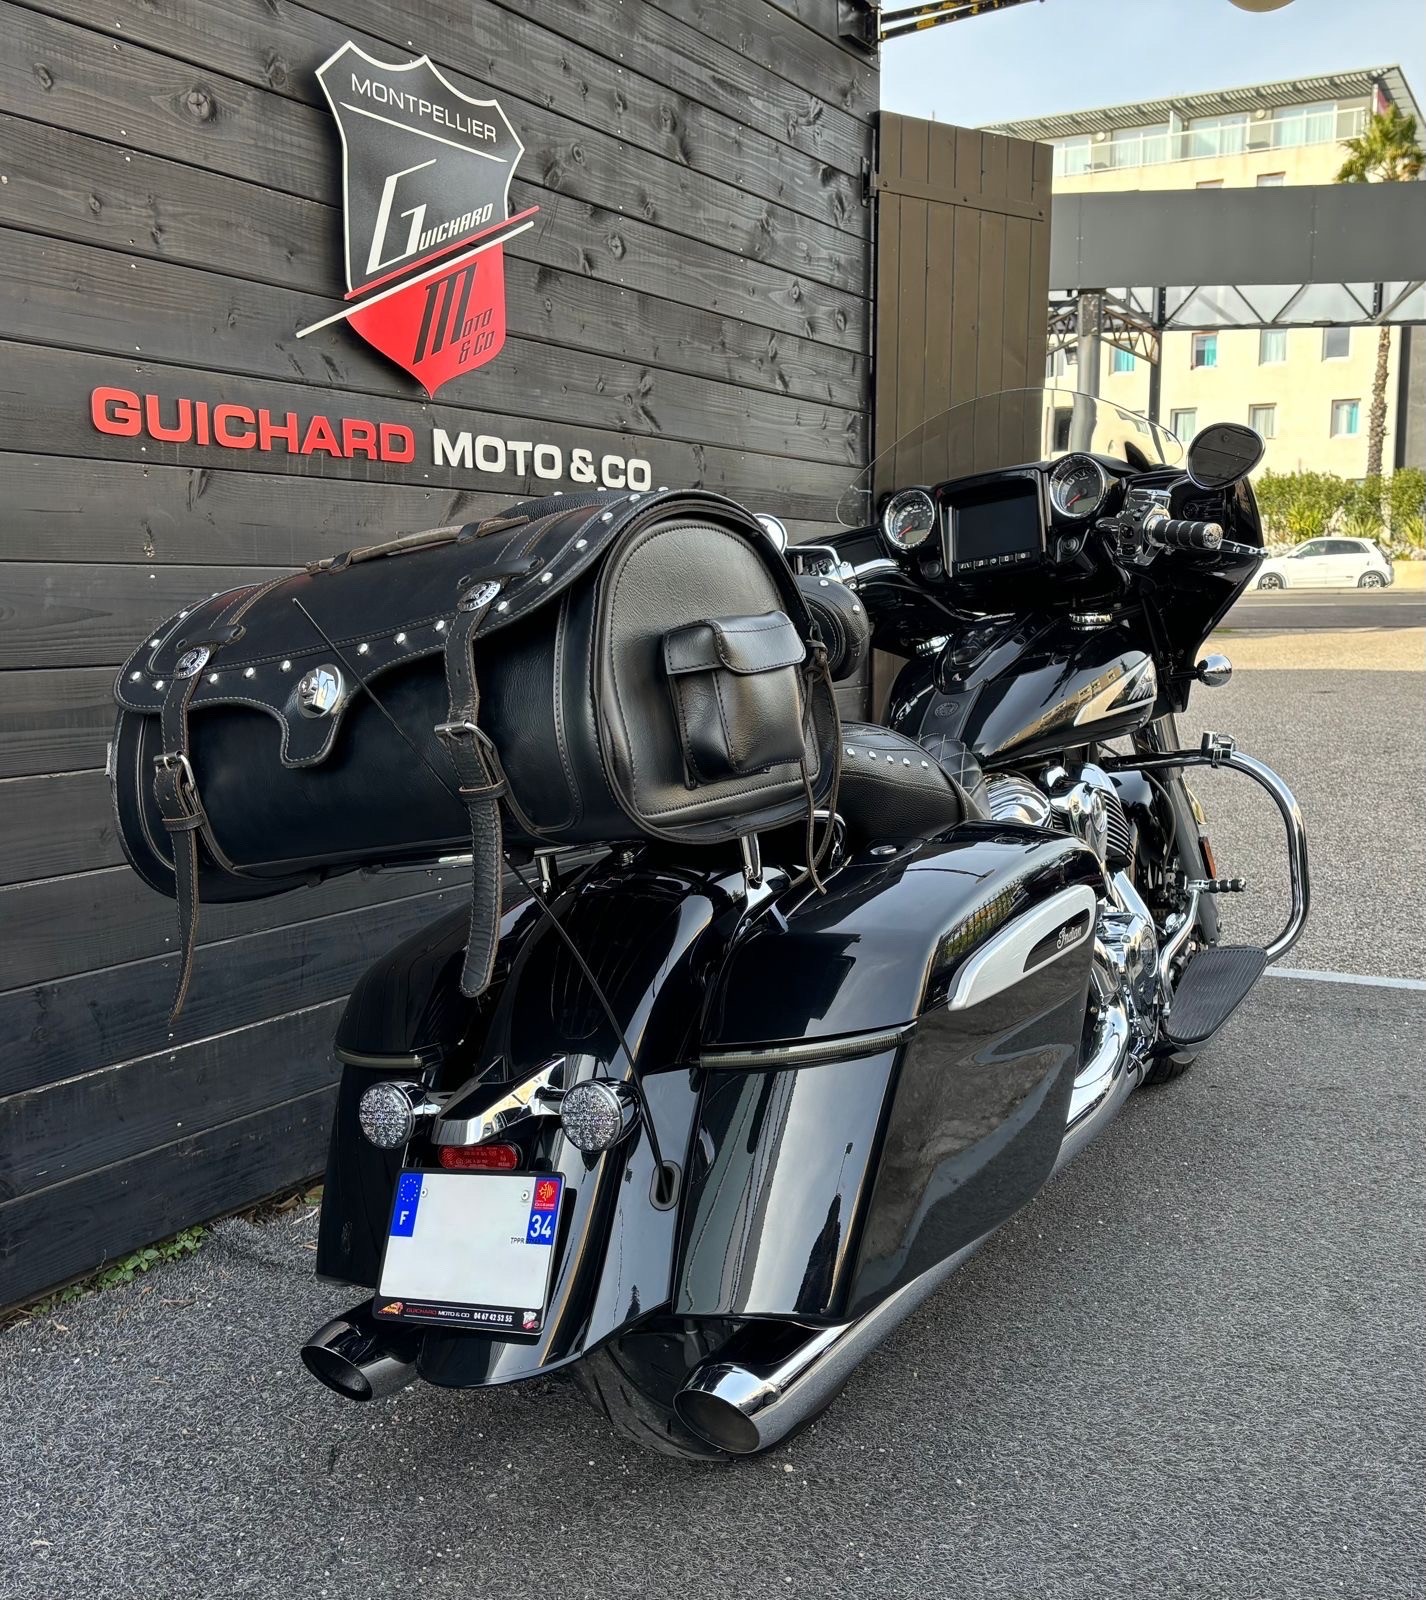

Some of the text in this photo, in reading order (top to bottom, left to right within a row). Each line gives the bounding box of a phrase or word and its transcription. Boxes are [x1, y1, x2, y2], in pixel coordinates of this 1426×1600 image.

[350, 72, 498, 144] MONTPELLIER
[91, 386, 415, 463] GUICHARD
[399, 1211, 410, 1226] F
[530, 1214, 552, 1239] 34
